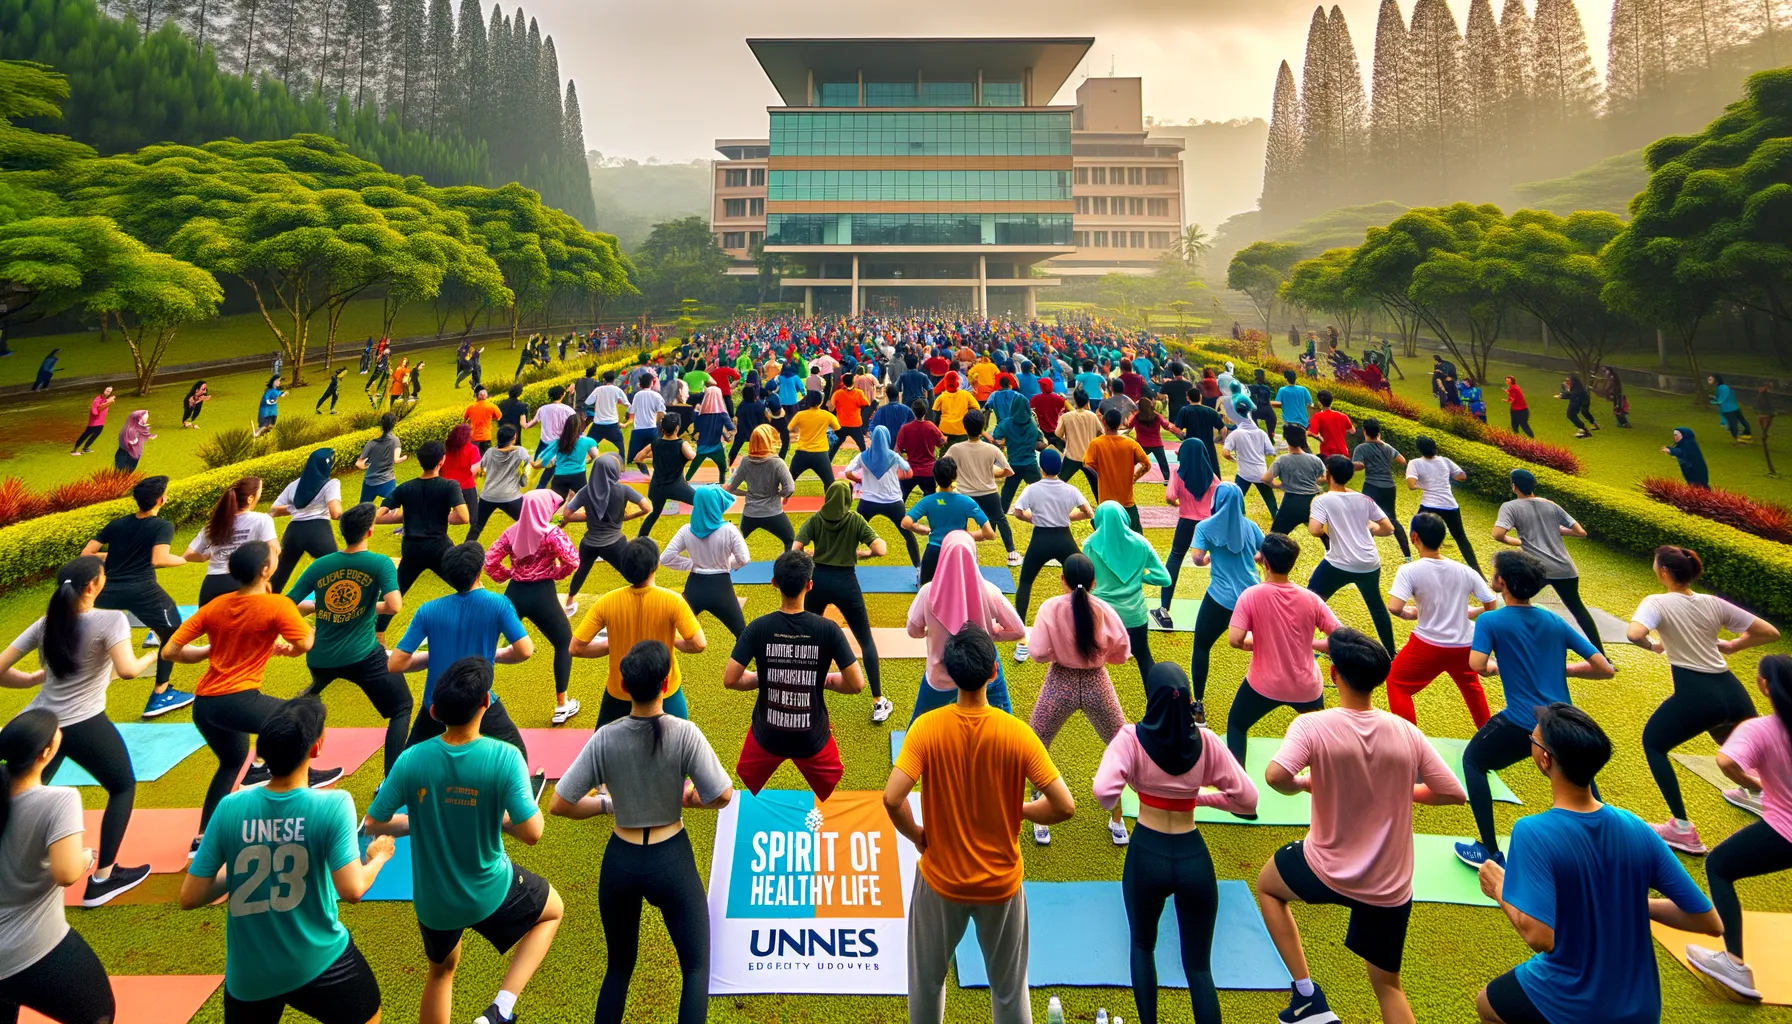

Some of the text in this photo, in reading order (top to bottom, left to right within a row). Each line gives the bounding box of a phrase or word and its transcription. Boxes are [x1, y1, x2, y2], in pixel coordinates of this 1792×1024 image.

[241, 817, 306, 843] UNESE
[750, 830, 882, 873] SPIRIT OF
[229, 843, 309, 917] 23
[750, 875, 882, 906] HEALTHY LIFE
[749, 928, 879, 958] UNNES
